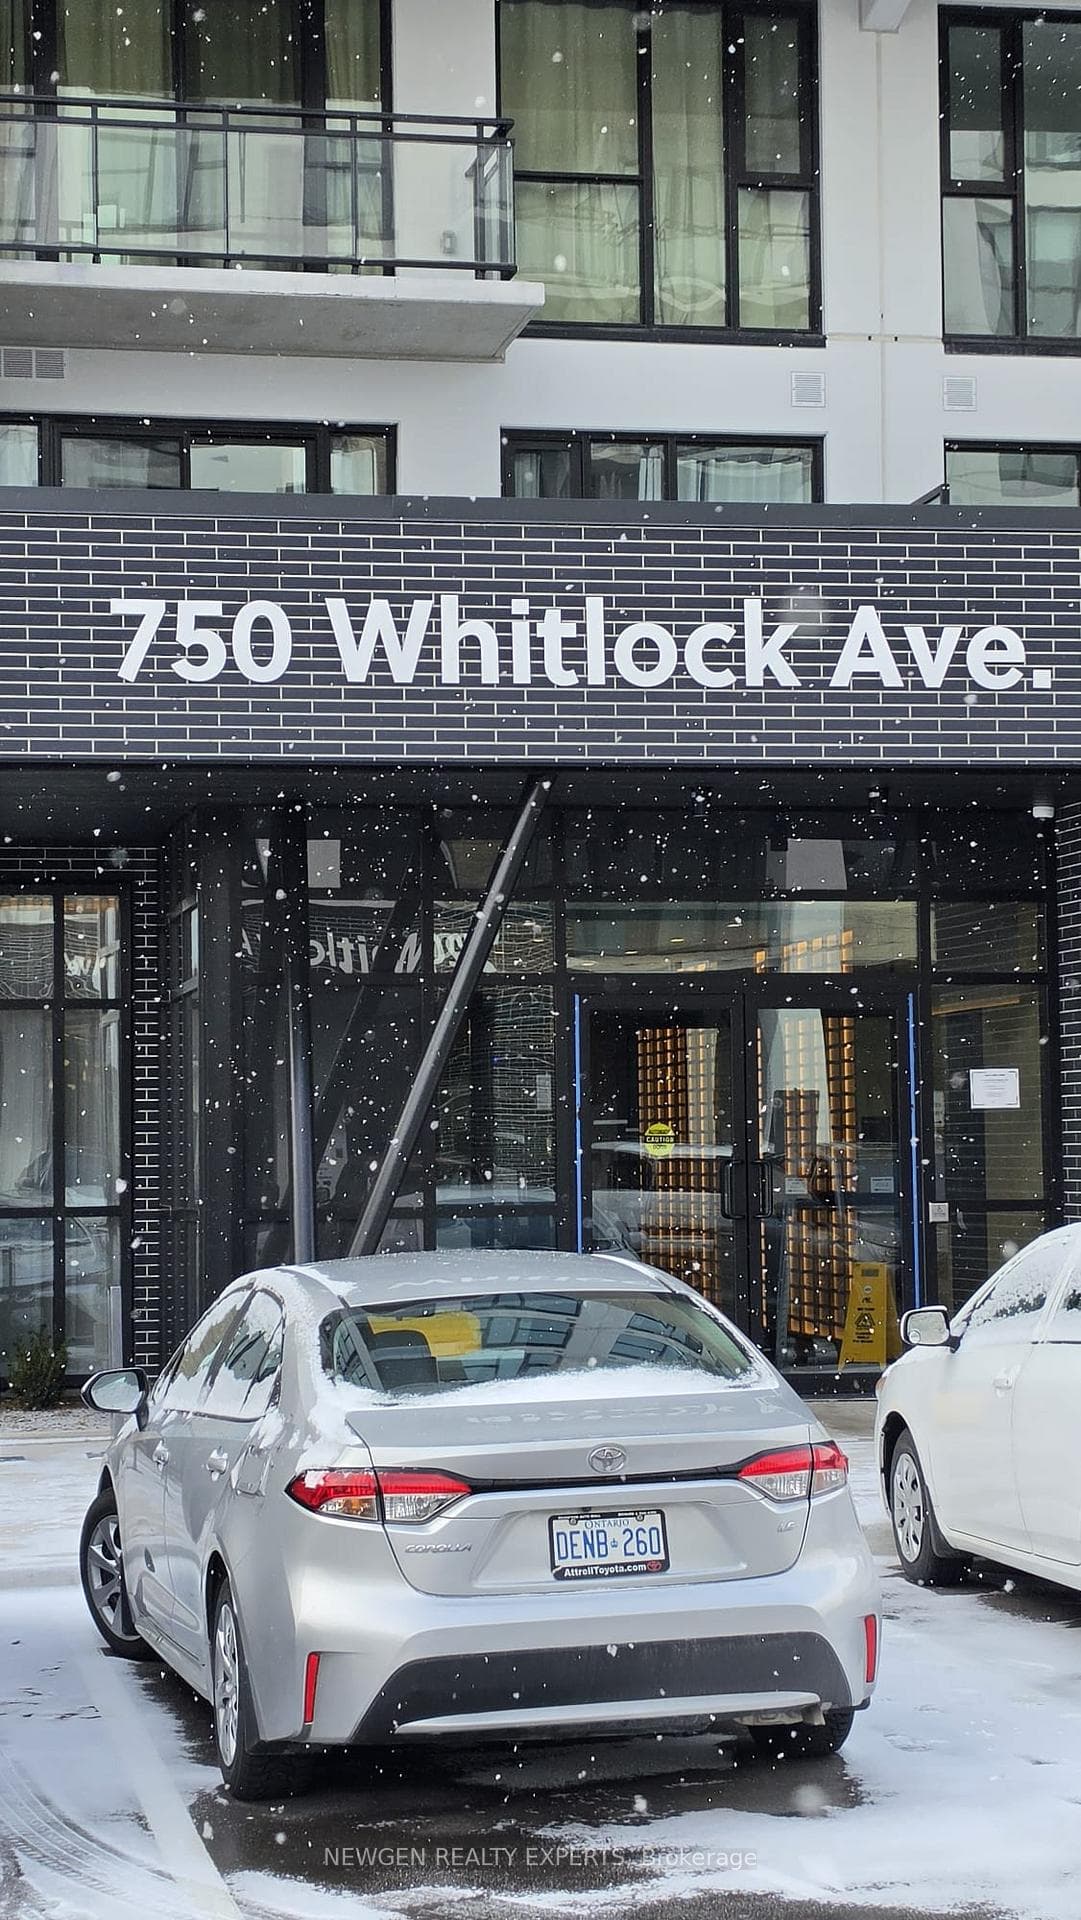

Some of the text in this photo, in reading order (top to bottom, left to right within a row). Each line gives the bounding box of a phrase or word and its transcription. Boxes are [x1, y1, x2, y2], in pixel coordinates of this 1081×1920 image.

[110, 594, 1052, 691] 750 Whitlock Ave.
[405, 1543, 473, 1554] COROLLA
[556, 1526, 662, 1561] DENB 260
